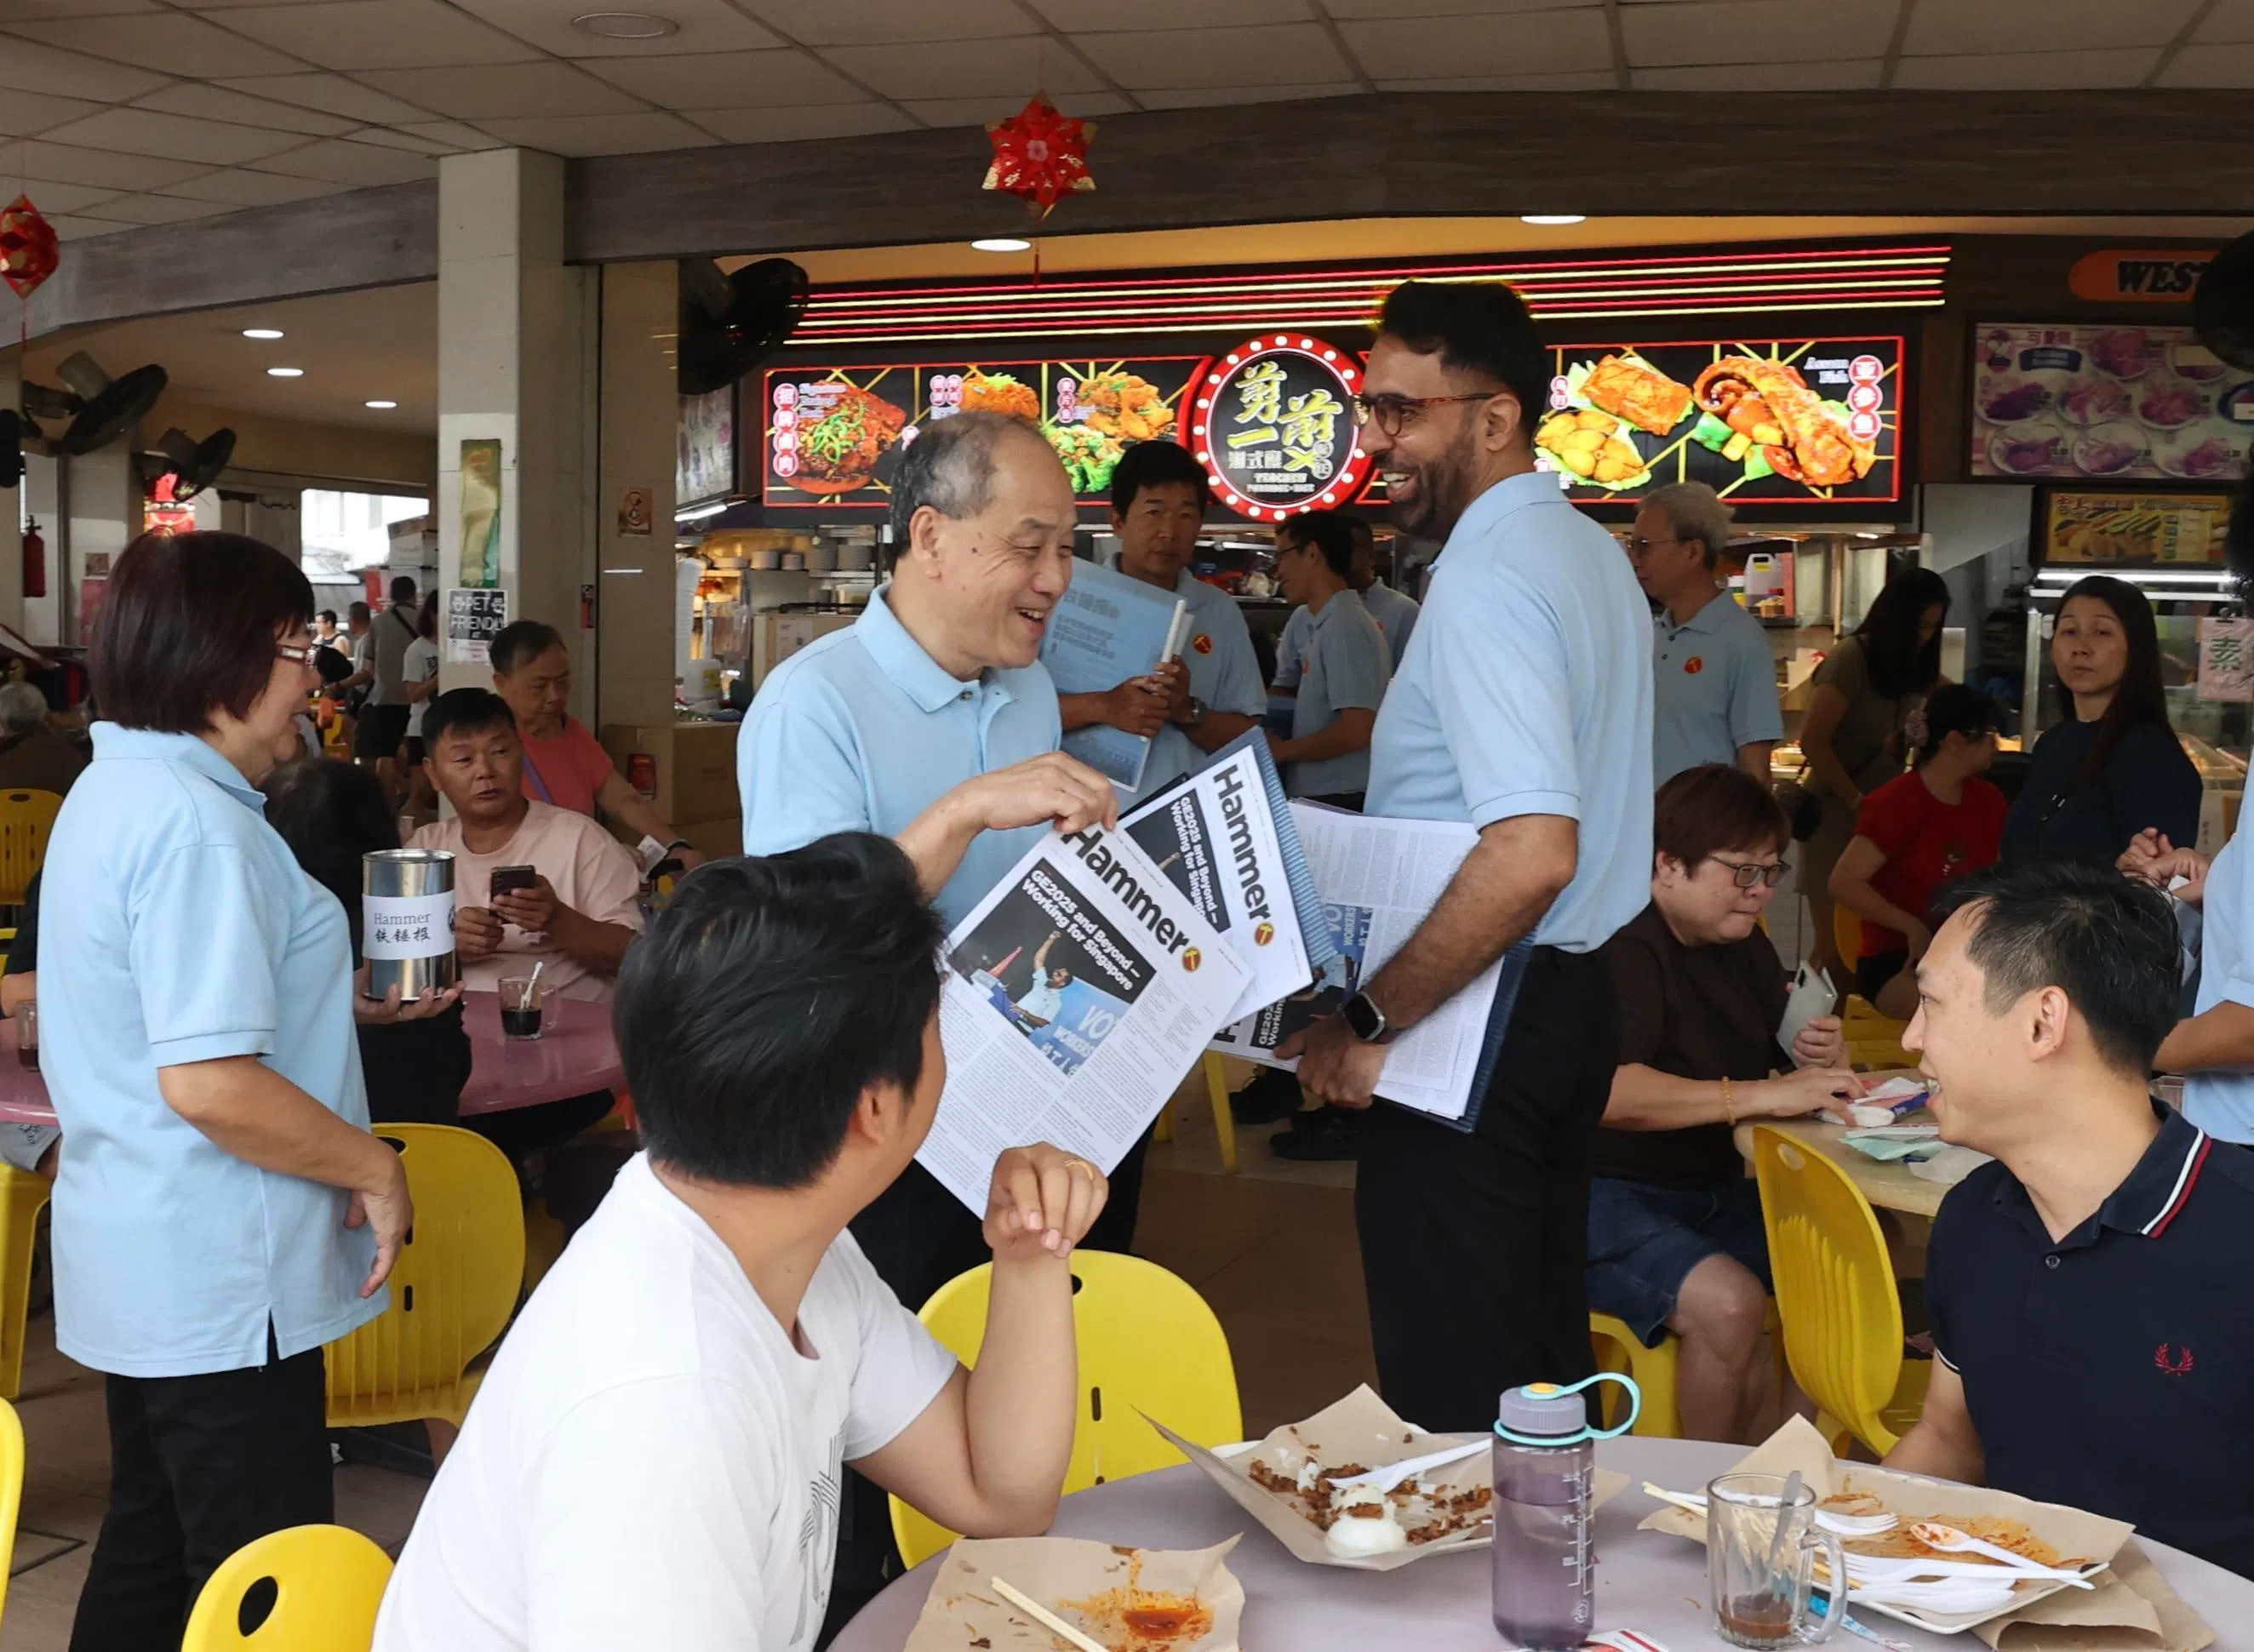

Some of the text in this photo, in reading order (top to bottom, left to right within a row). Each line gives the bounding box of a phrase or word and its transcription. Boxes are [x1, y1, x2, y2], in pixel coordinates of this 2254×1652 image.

[1180, 796, 1202, 844] GE2025
[1213, 763, 1271, 920] Hammer
[1170, 801, 1207, 919] Working for Singapo
[1193, 843, 1207, 868] and
[1061, 829, 1190, 955] Hammer
[1196, 863, 1218, 917] Beyond
[374, 912, 432, 925] Hammer
[1021, 877, 1134, 991] Working for Singapore
[1031, 869, 1078, 915] GE2025
[1073, 912, 1096, 935] and
[1092, 929, 1135, 969] Beyond
[1077, 1004, 1117, 1039] VO
[1259, 1003, 1275, 1045] GE202
